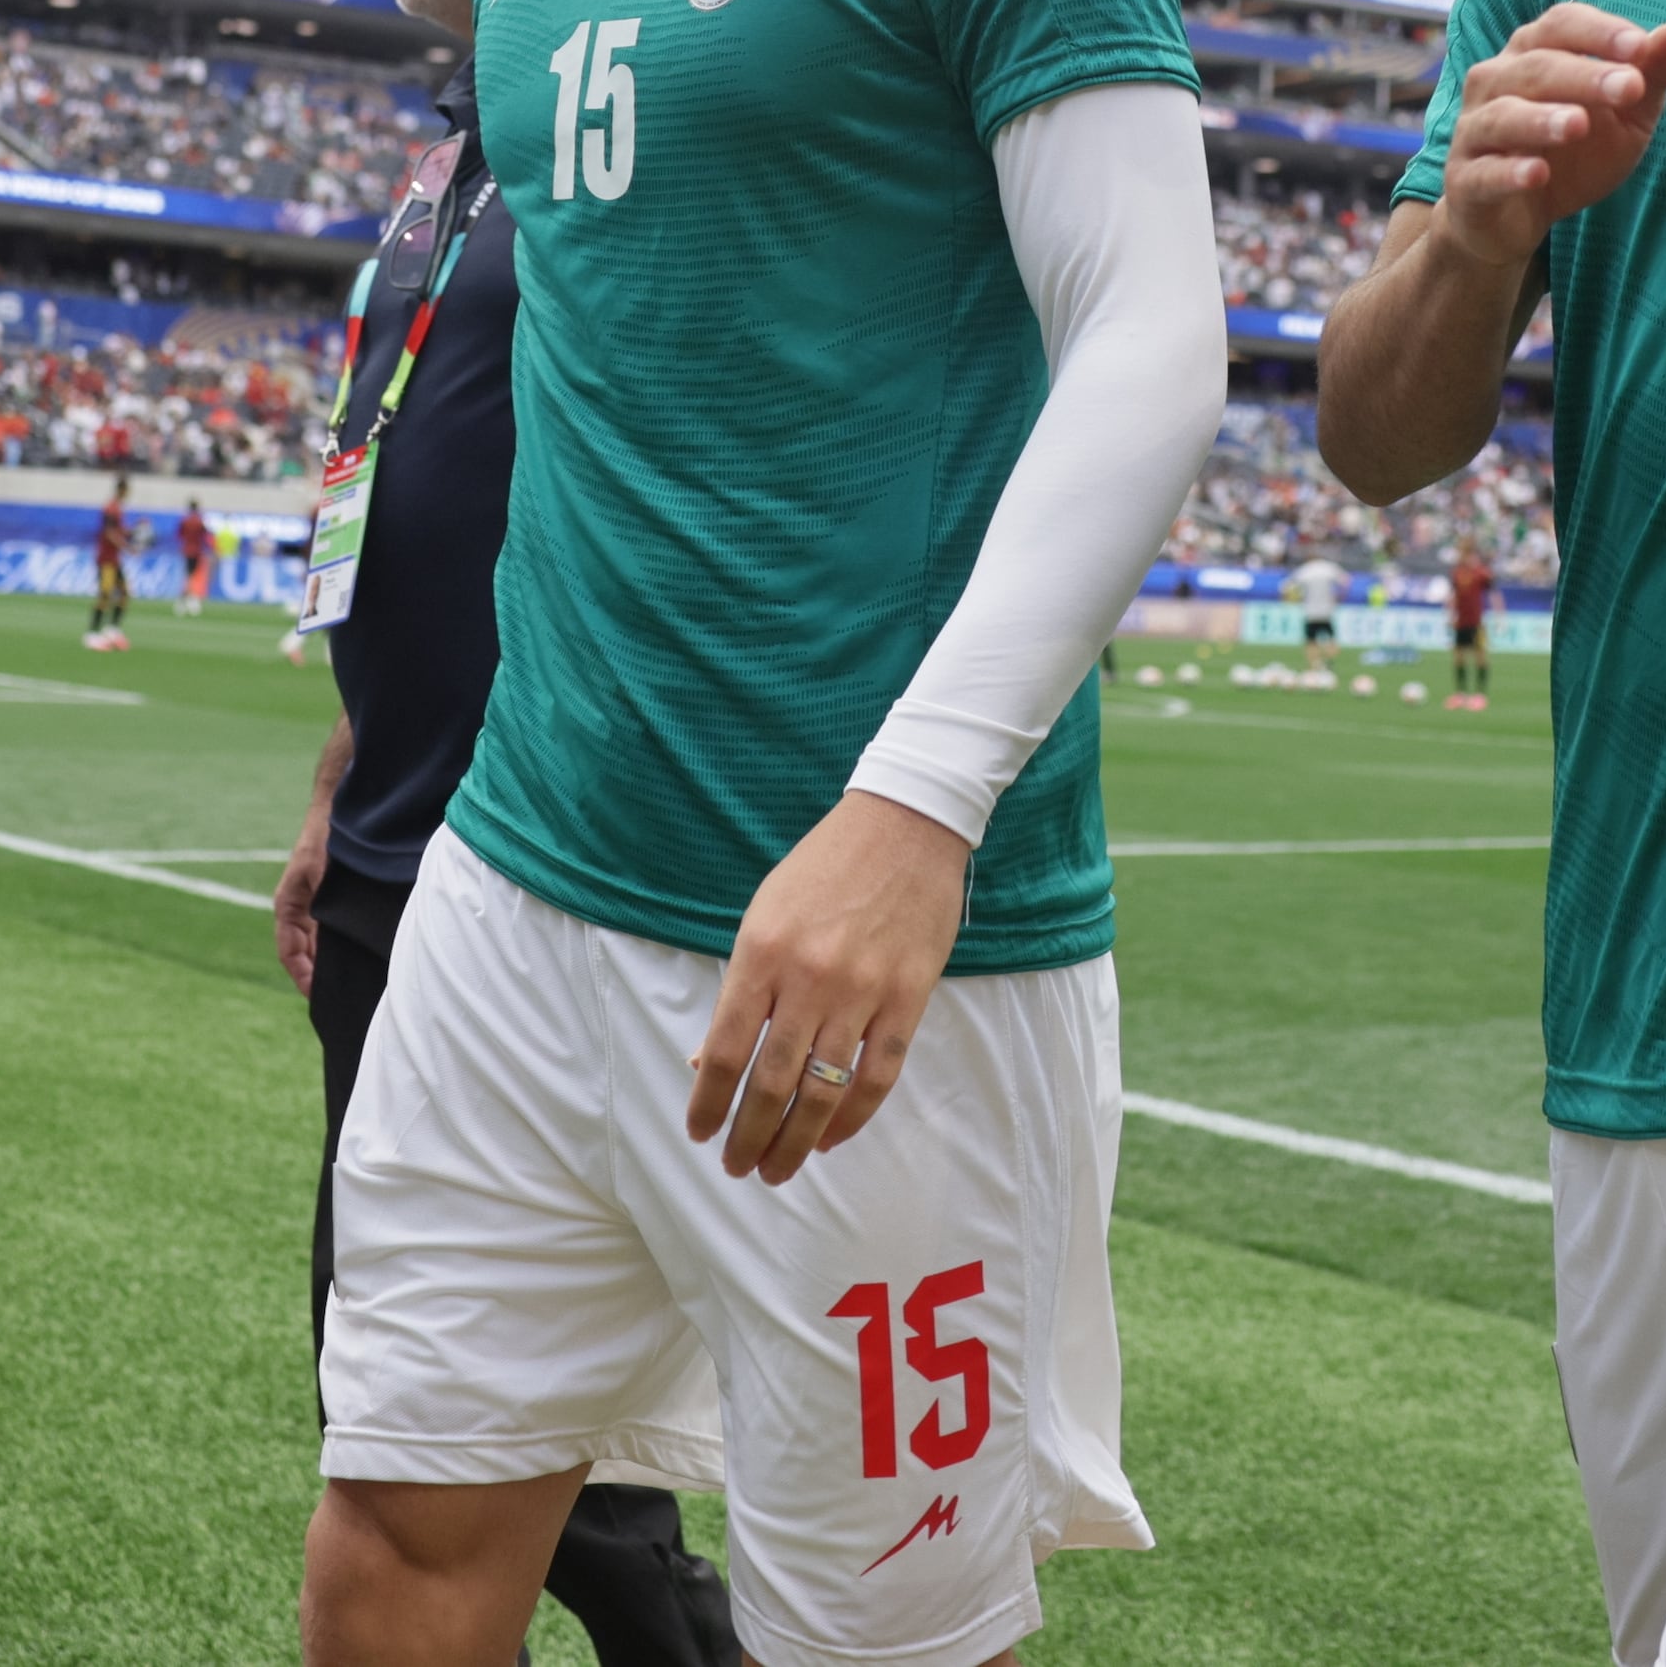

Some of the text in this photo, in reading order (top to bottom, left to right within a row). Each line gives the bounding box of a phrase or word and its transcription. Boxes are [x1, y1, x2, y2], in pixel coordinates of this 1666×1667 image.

[468, 181, 497, 218] FIFA
[549, 18, 643, 201] 15
[825, 1260, 990, 1479] 15
